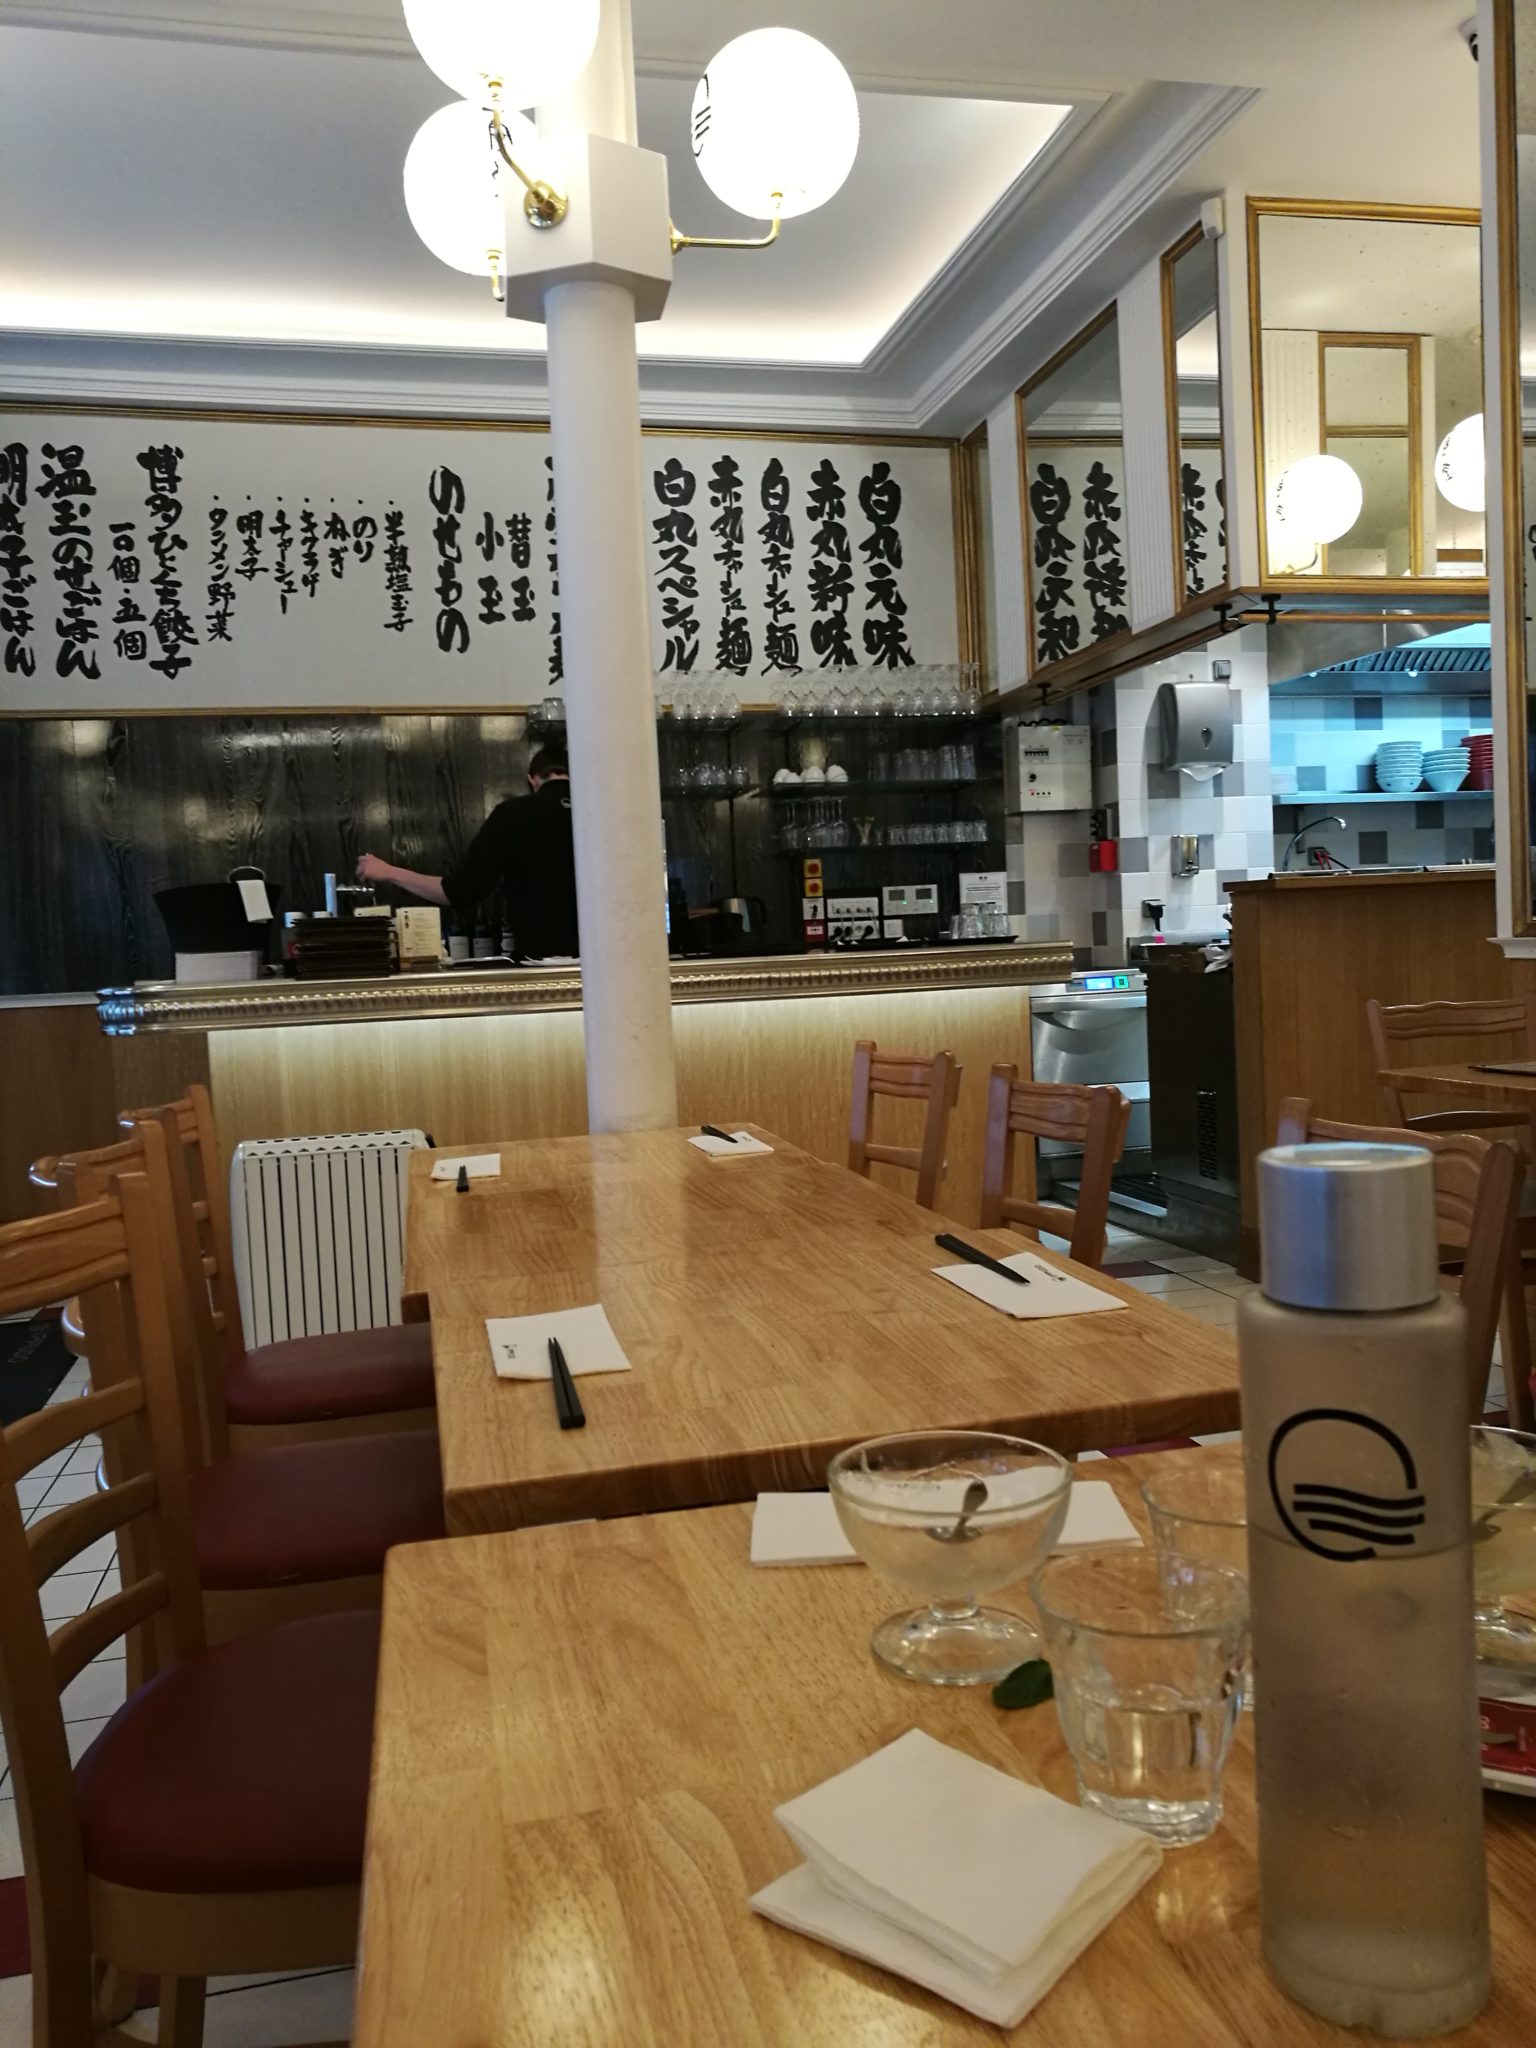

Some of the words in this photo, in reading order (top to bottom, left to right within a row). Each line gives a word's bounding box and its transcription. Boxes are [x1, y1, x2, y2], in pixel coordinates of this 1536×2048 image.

[428, 465, 471, 654] のせもの
[475, 511, 508, 625] 小玉
[504, 512, 536, 622] 替玉
[652, 457, 701, 673] 白丸スペシャル
[806, 458, 859, 669] 赤丸新味
